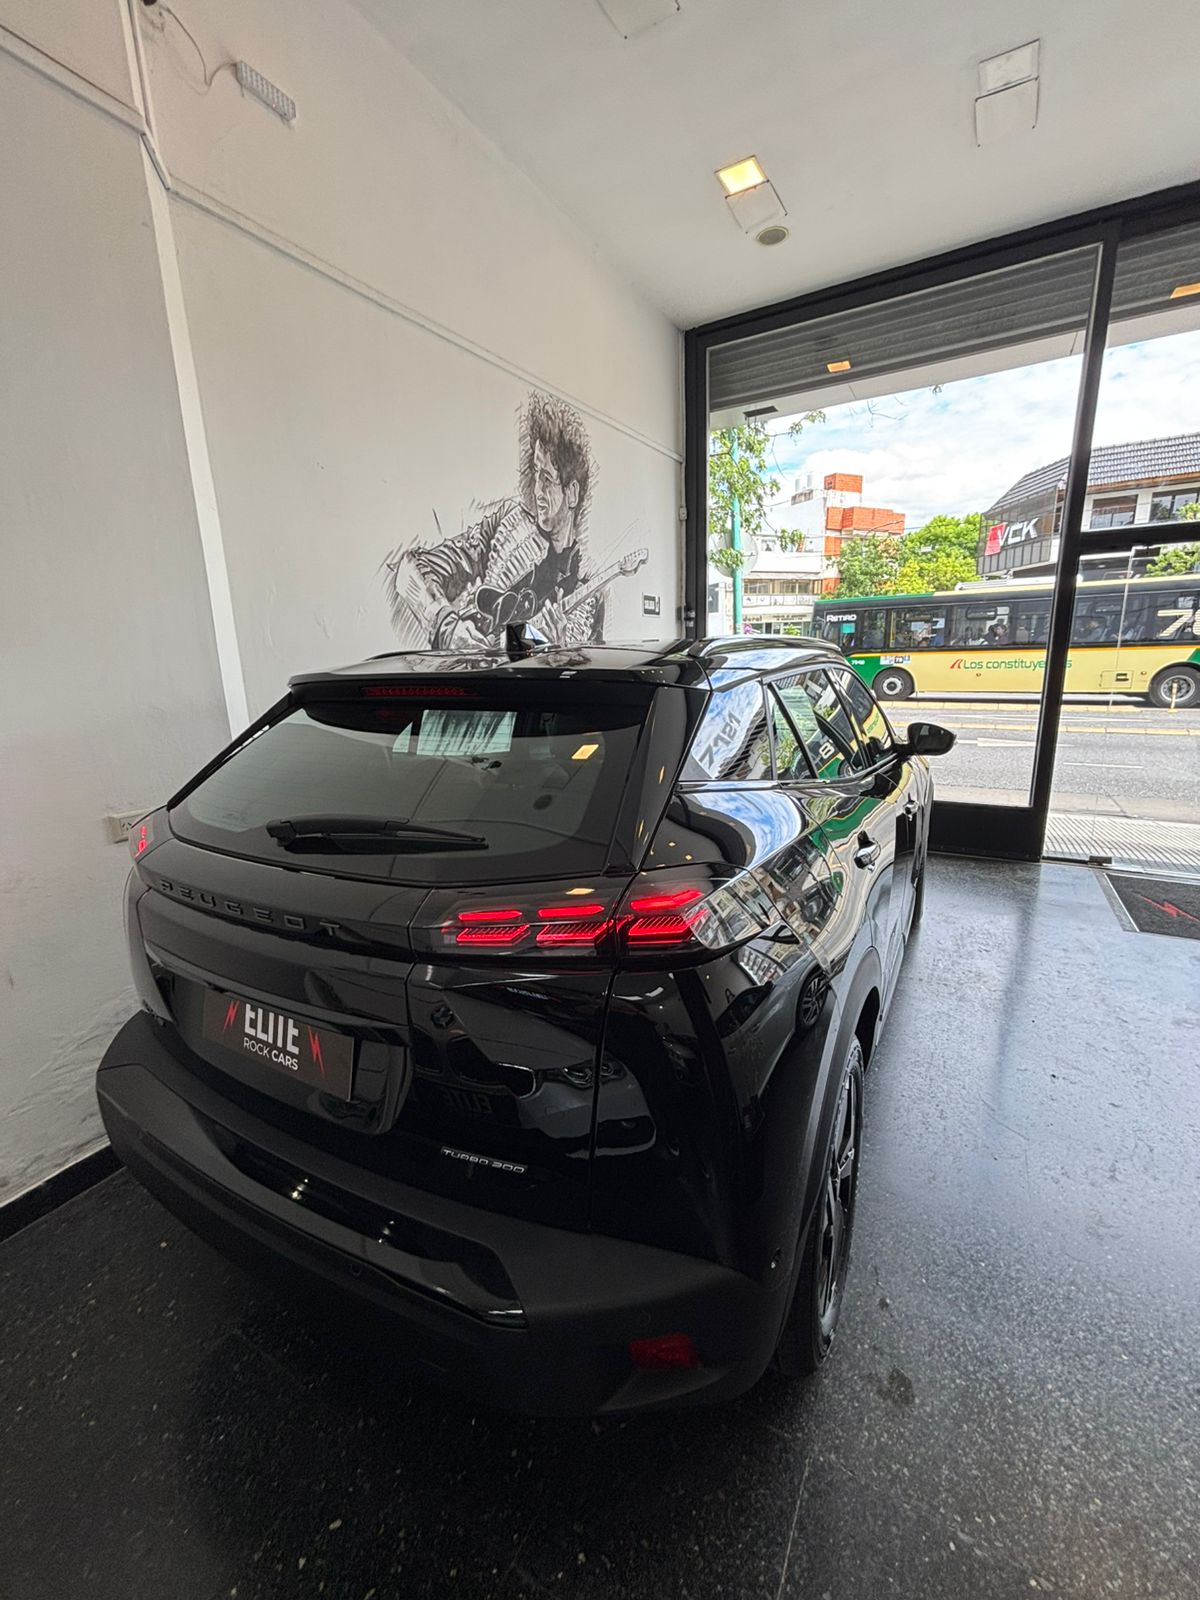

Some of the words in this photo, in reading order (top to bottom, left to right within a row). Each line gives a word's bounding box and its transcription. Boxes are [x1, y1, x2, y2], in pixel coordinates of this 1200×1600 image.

[1157, 608, 1200, 637] 7
[963, 660, 983, 669] Los
[985, 658, 1073, 671] constituyes
[160, 879, 341, 937] PEUGEOT
[244, 1003, 300, 1055] ELITE
[243, 1037, 270, 1058] ROCK
[271, 1050, 299, 1071] CARS
[443, 1149, 489, 1166] TURBO
